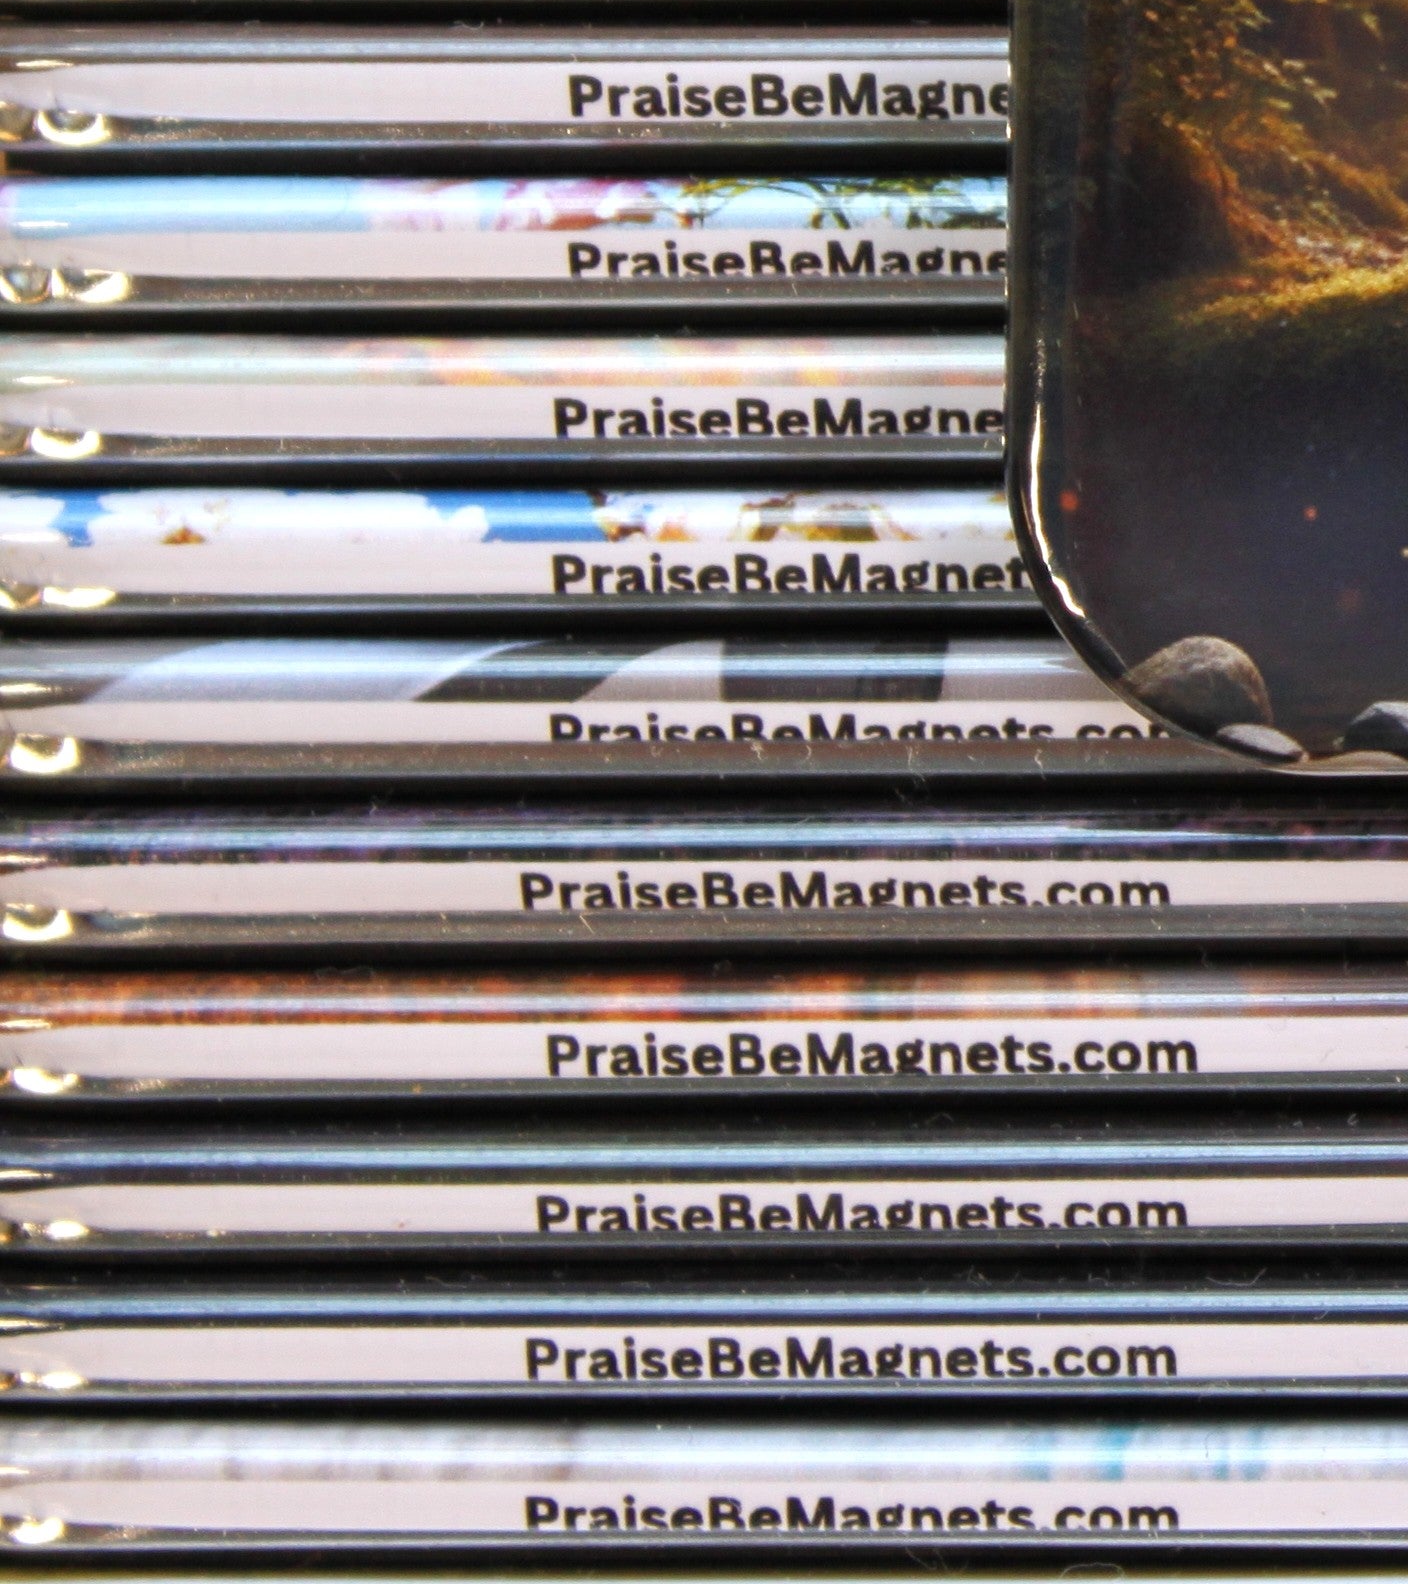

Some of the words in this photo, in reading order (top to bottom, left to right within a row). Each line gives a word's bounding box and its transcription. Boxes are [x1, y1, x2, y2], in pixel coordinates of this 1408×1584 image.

[568, 72, 1008, 119] PraiseBeMagne
[567, 240, 1005, 277] PraiseBeMagne
[553, 396, 1003, 437] PraiseBeMagne
[551, 553, 1030, 593] PraiseBeMagnet
[519, 871, 1170, 909] PraiseBeMagnets.com
[546, 1032, 1198, 1077] PraiseBeMagnets.com
[536, 1193, 1187, 1232] PraiseBeMagnets.com
[525, 1335, 1178, 1380] PraiseBeMagnets.com
[525, 1493, 1179, 1531] PraiseBeMagnetscom
